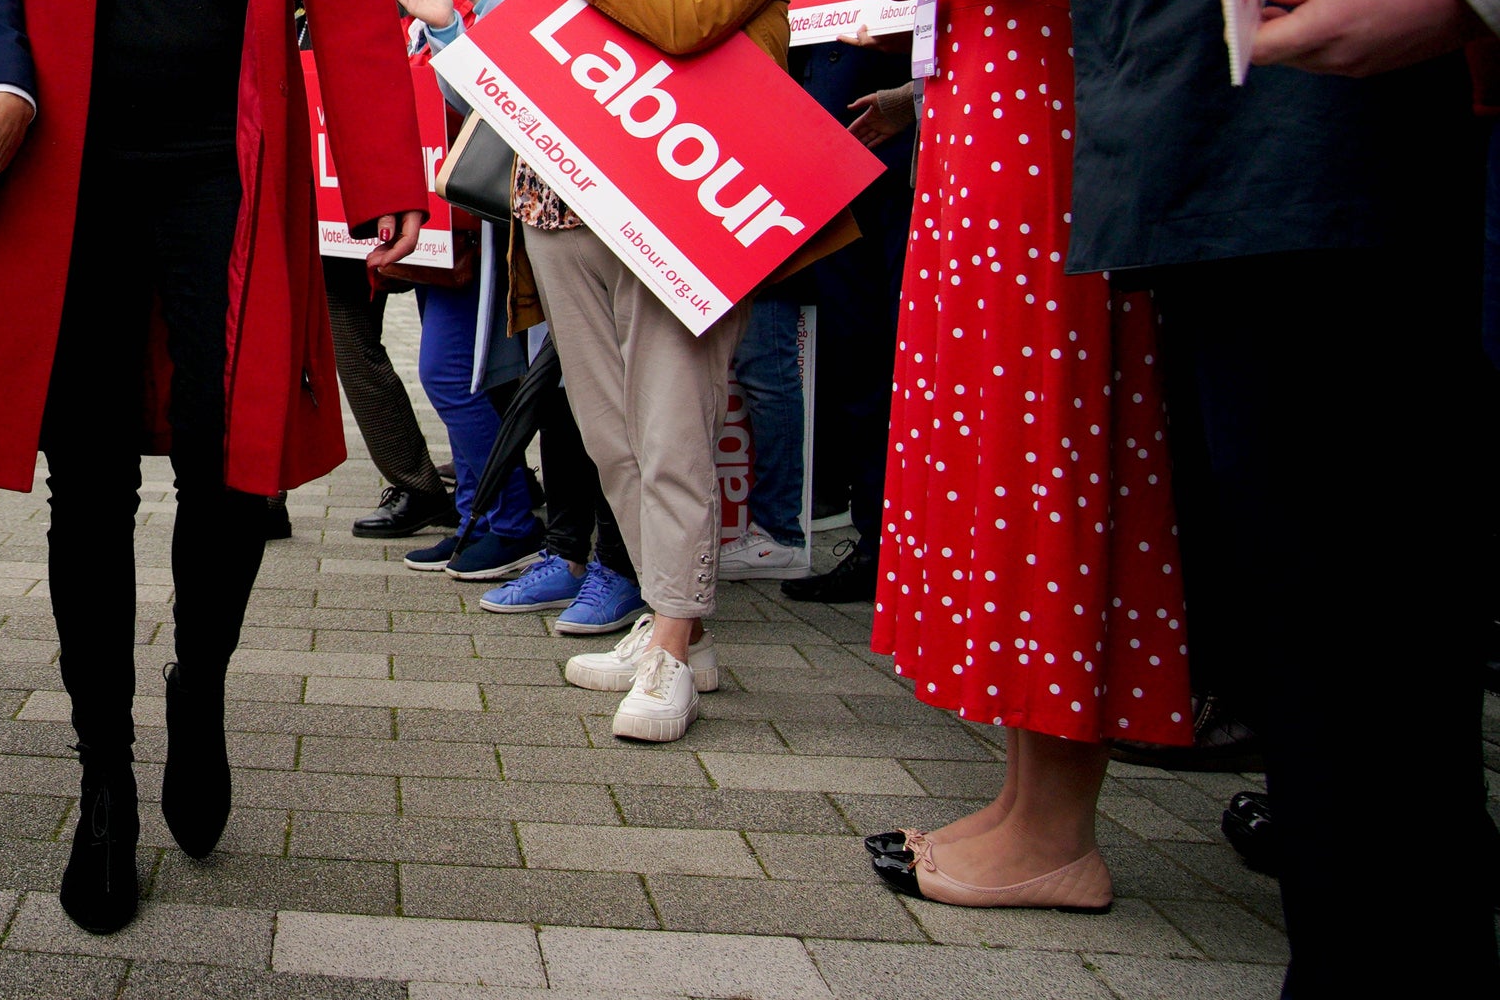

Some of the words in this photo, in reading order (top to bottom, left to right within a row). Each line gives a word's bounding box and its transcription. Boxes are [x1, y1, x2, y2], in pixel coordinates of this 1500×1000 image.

[818, 9, 861, 27] Labour
[474, 67, 518, 120] Vote
[525, 120, 598, 193] Labour
[321, 227, 342, 242] Vote
[619, 220, 712, 318] labour.org.uk
